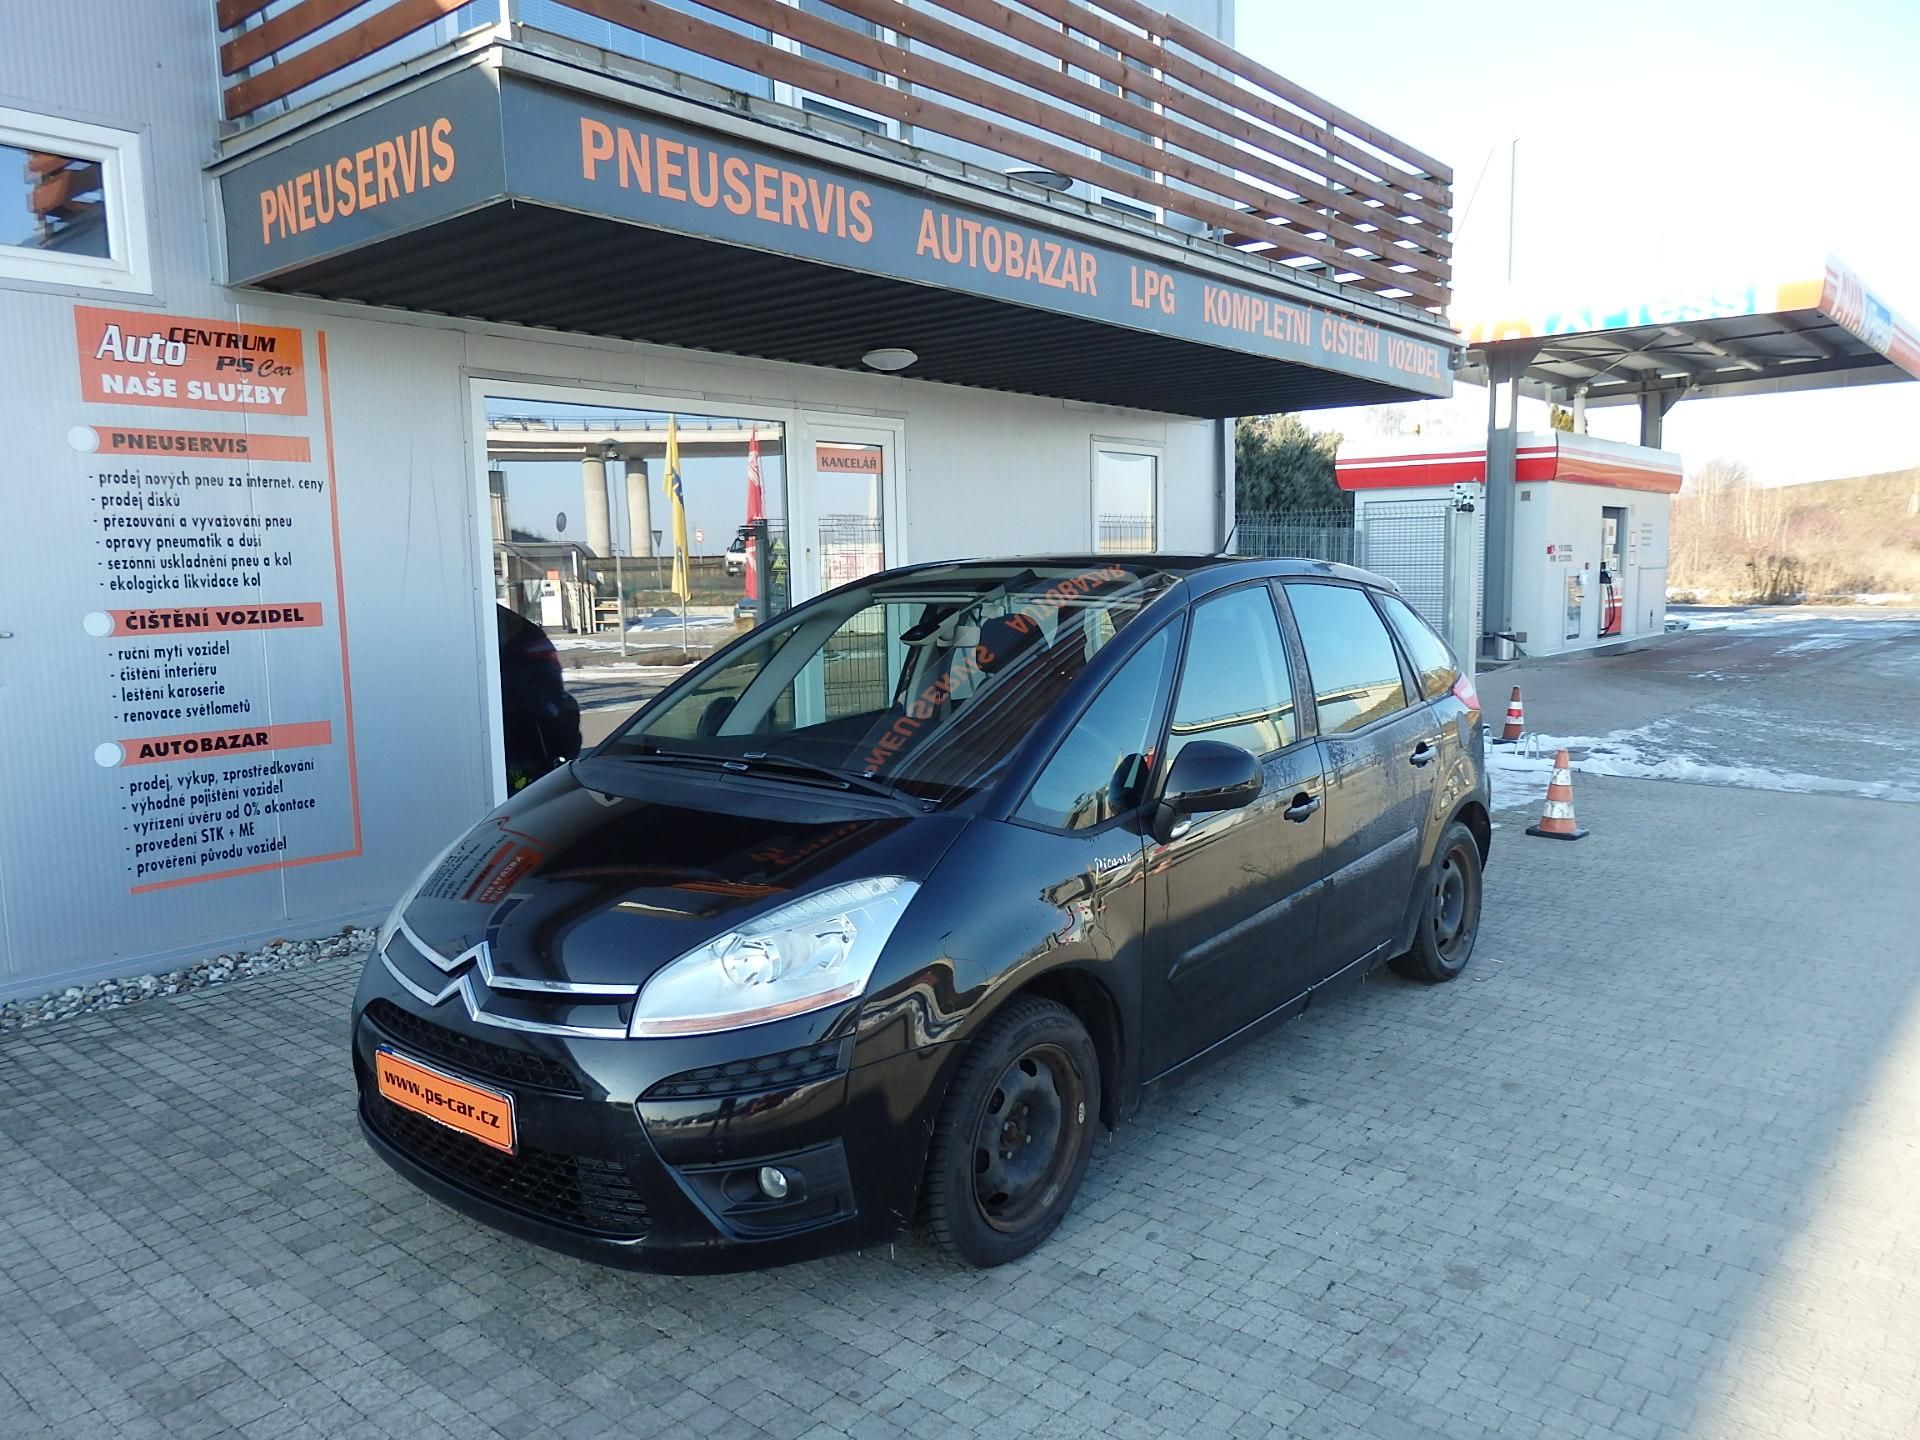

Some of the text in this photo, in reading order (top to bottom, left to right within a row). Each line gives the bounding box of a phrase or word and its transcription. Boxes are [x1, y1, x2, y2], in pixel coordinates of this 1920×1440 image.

[260, 117, 455, 245] PNEUSERVIS
[580, 116, 1441, 379] PNEUSERVIS AUTOBAZAR LPG KOMPLETNÍ ČIŠTĚNÍ VOZIDEL
[96, 323, 276, 367] Auto CENTRUM
[216, 355, 294, 378] PS Car
[102, 371, 287, 405] NAŠE SLUŽBY
[112, 432, 248, 454] PNEUSERVIS
[821, 456, 877, 469] KANCELÁŘ
[99, 469, 324, 493] prodej nových pneu za internet. ceny
[101, 491, 180, 510] prodej disků
[104, 514, 292, 531] přezouvání a vyvažování pneu
[105, 538, 151, 552] opravy
[157, 532, 223, 552] pneumatik
[227, 537, 234, 547] a
[108, 552, 292, 571] sezónní uskladnění pneu a kol
[110, 572, 261, 594] ekologická likvidace kol
[125, 608, 304, 630] ČIŠTĚNÍ VOZIDEL
[118, 644, 150, 661] ruční
[187, 639, 230, 656] vozidel
[120, 662, 217, 681] čištění interiéru
[122, 681, 225, 702] leštění karoserie
[124, 698, 251, 723] renovace světlometů
[139, 732, 269, 759] AUTOBAZAR
[130, 757, 315, 796] prodej, výkup, zprostředkování
[131, 778, 283, 816] výhodné pojištění vozidel
[133, 796, 316, 837] vyřízení úvěru od 0% akontace
[135, 832, 198, 857] provedení
[201, 826, 225, 843] STK
[239, 821, 255, 838] ME
[137, 835, 287, 878] prověření původu vozidel
[384, 1070, 501, 1129] www.ps-car.cz
